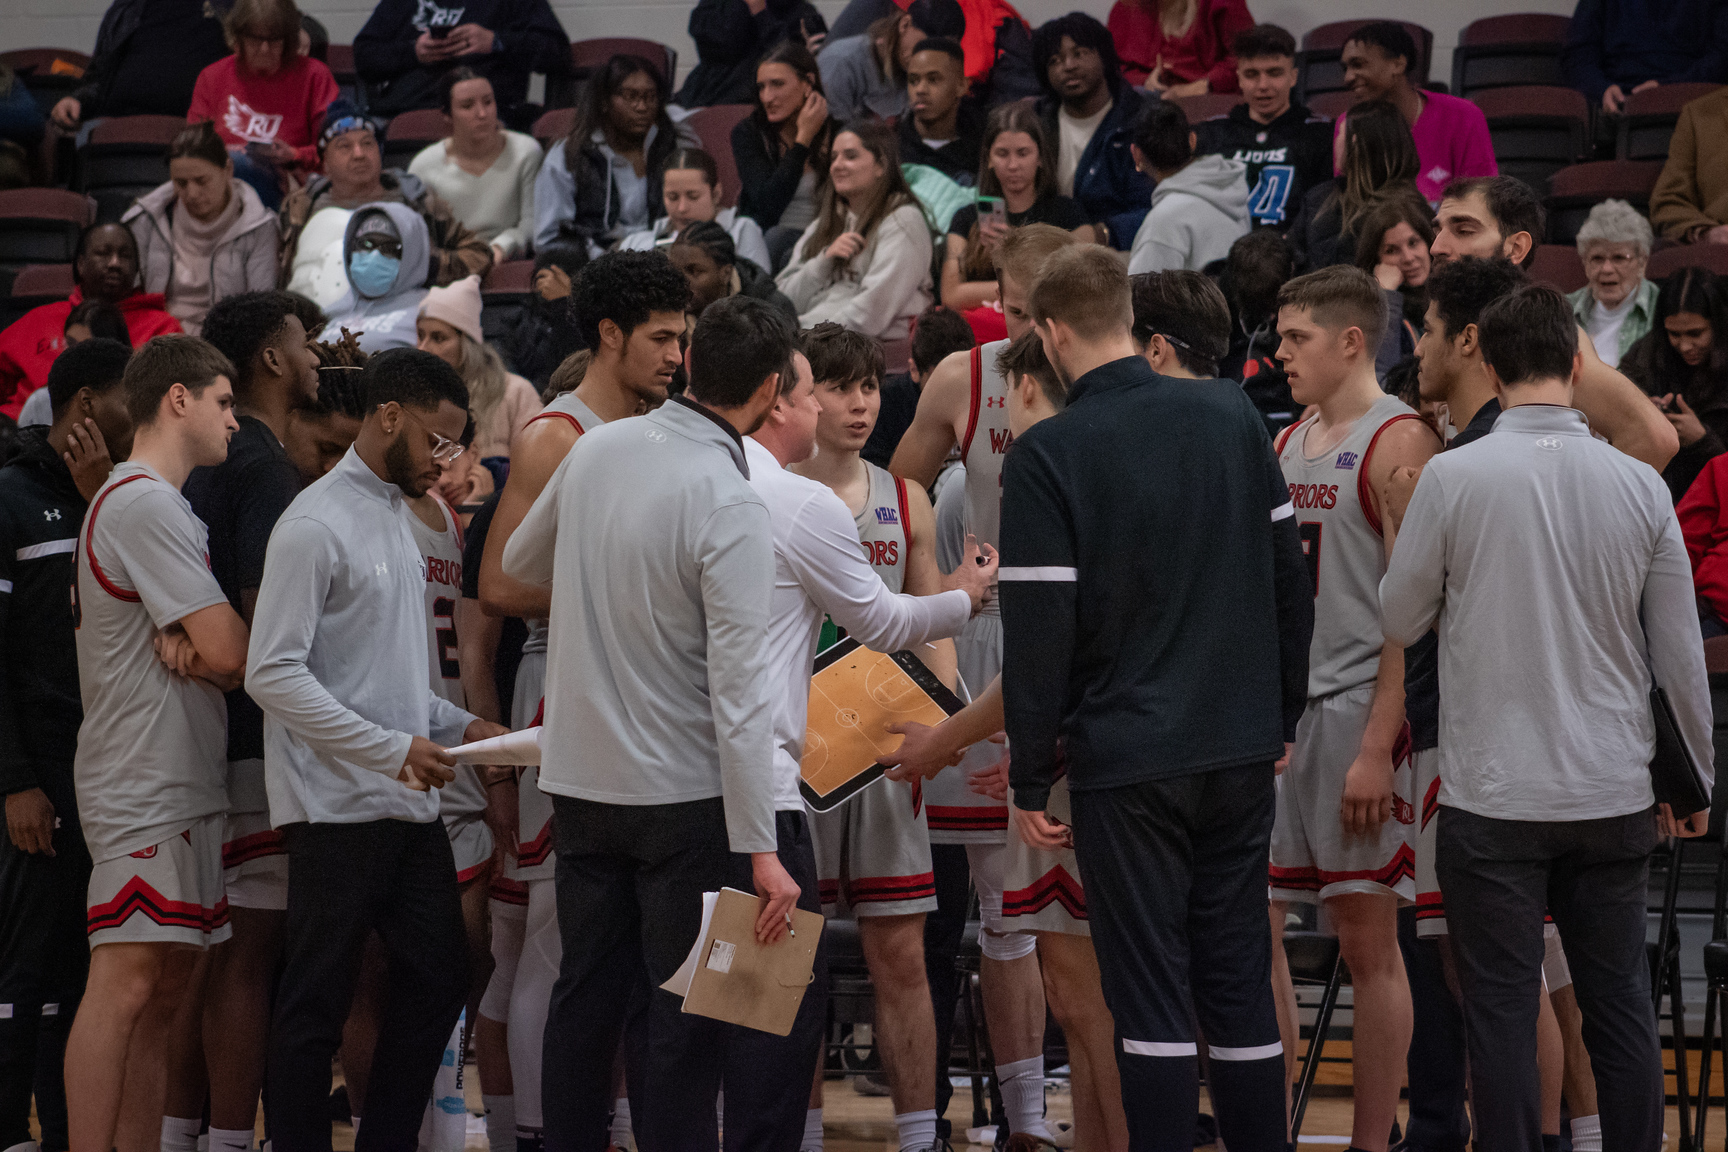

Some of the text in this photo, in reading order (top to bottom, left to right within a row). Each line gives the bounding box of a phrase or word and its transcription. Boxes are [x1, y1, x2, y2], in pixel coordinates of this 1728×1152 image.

[246, 113, 283, 140] RU
[1232, 147, 1288, 163] LIONS
[1336, 452, 1359, 467] WHAC
[875, 507, 898, 521] WHAC
